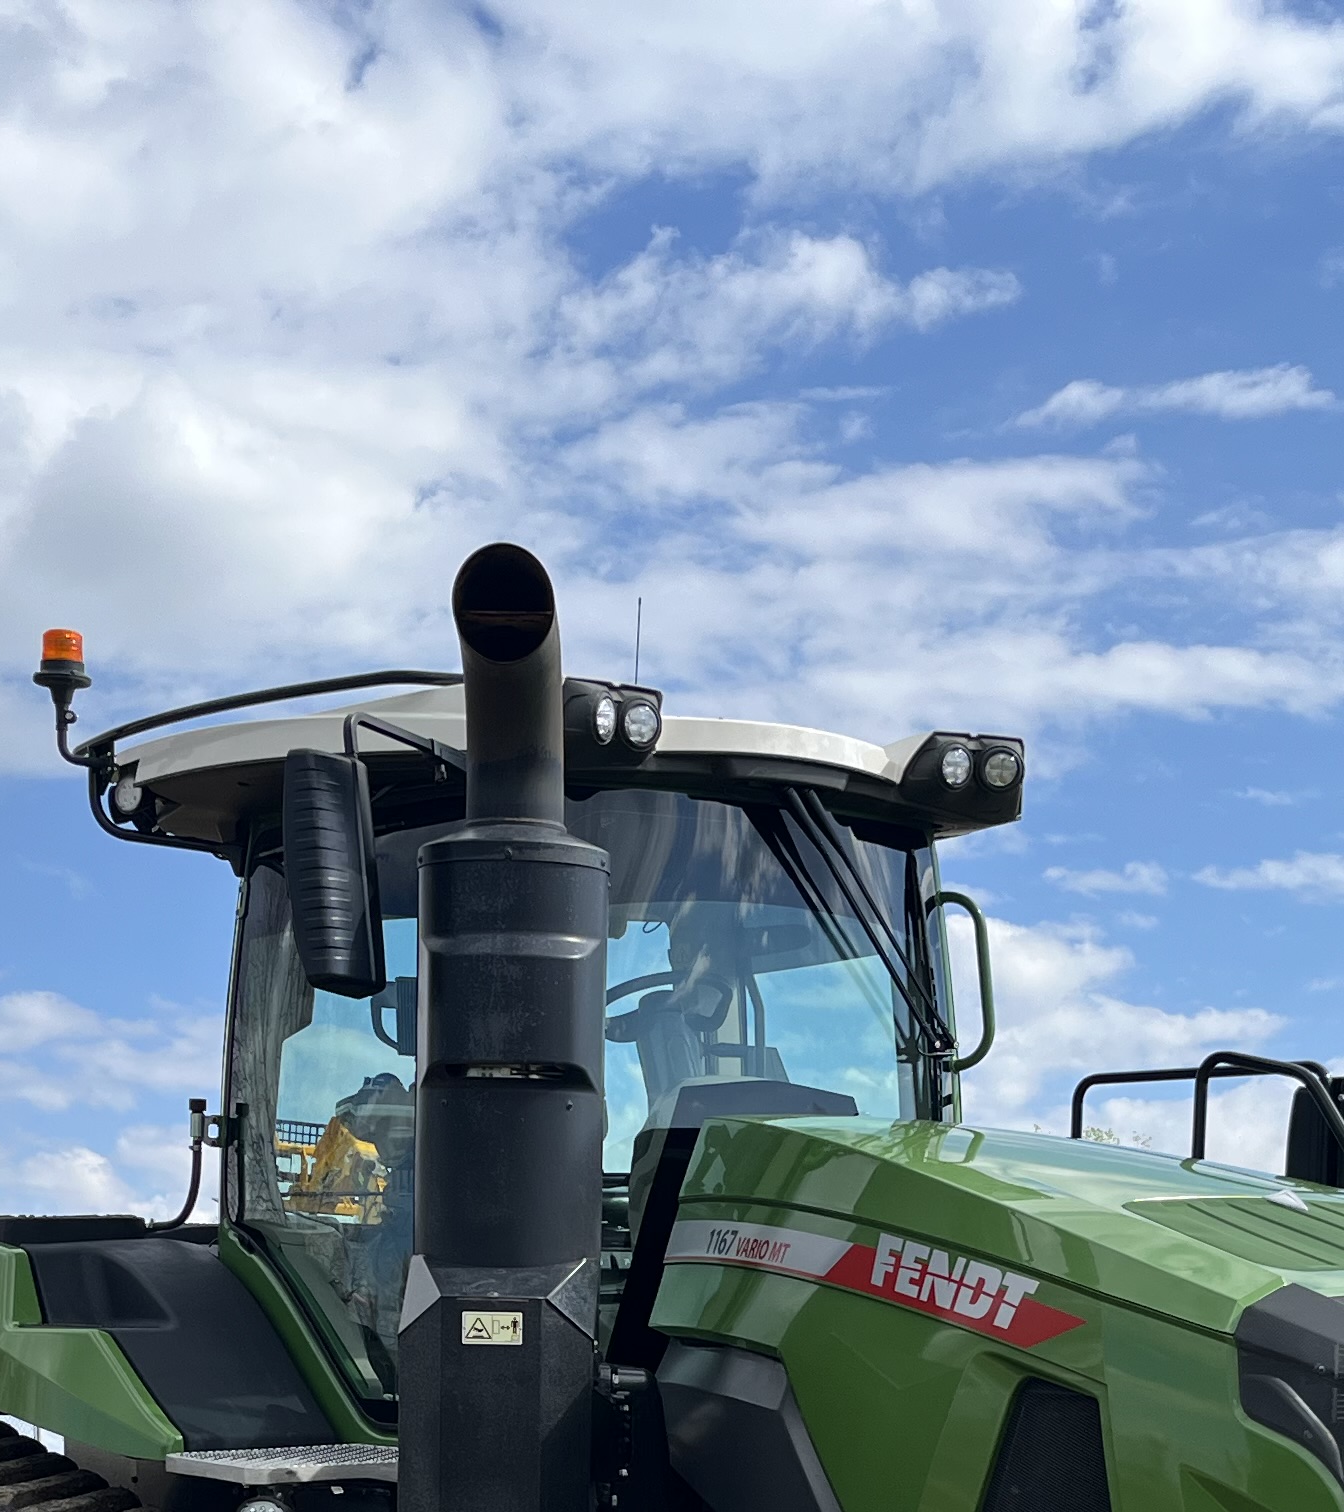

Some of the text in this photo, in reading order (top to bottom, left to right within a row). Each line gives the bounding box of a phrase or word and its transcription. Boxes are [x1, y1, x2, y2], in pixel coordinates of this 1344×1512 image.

[706, 1228, 791, 1264] 1167 VARIO MT
[870, 1232, 1040, 1330] FENDT
